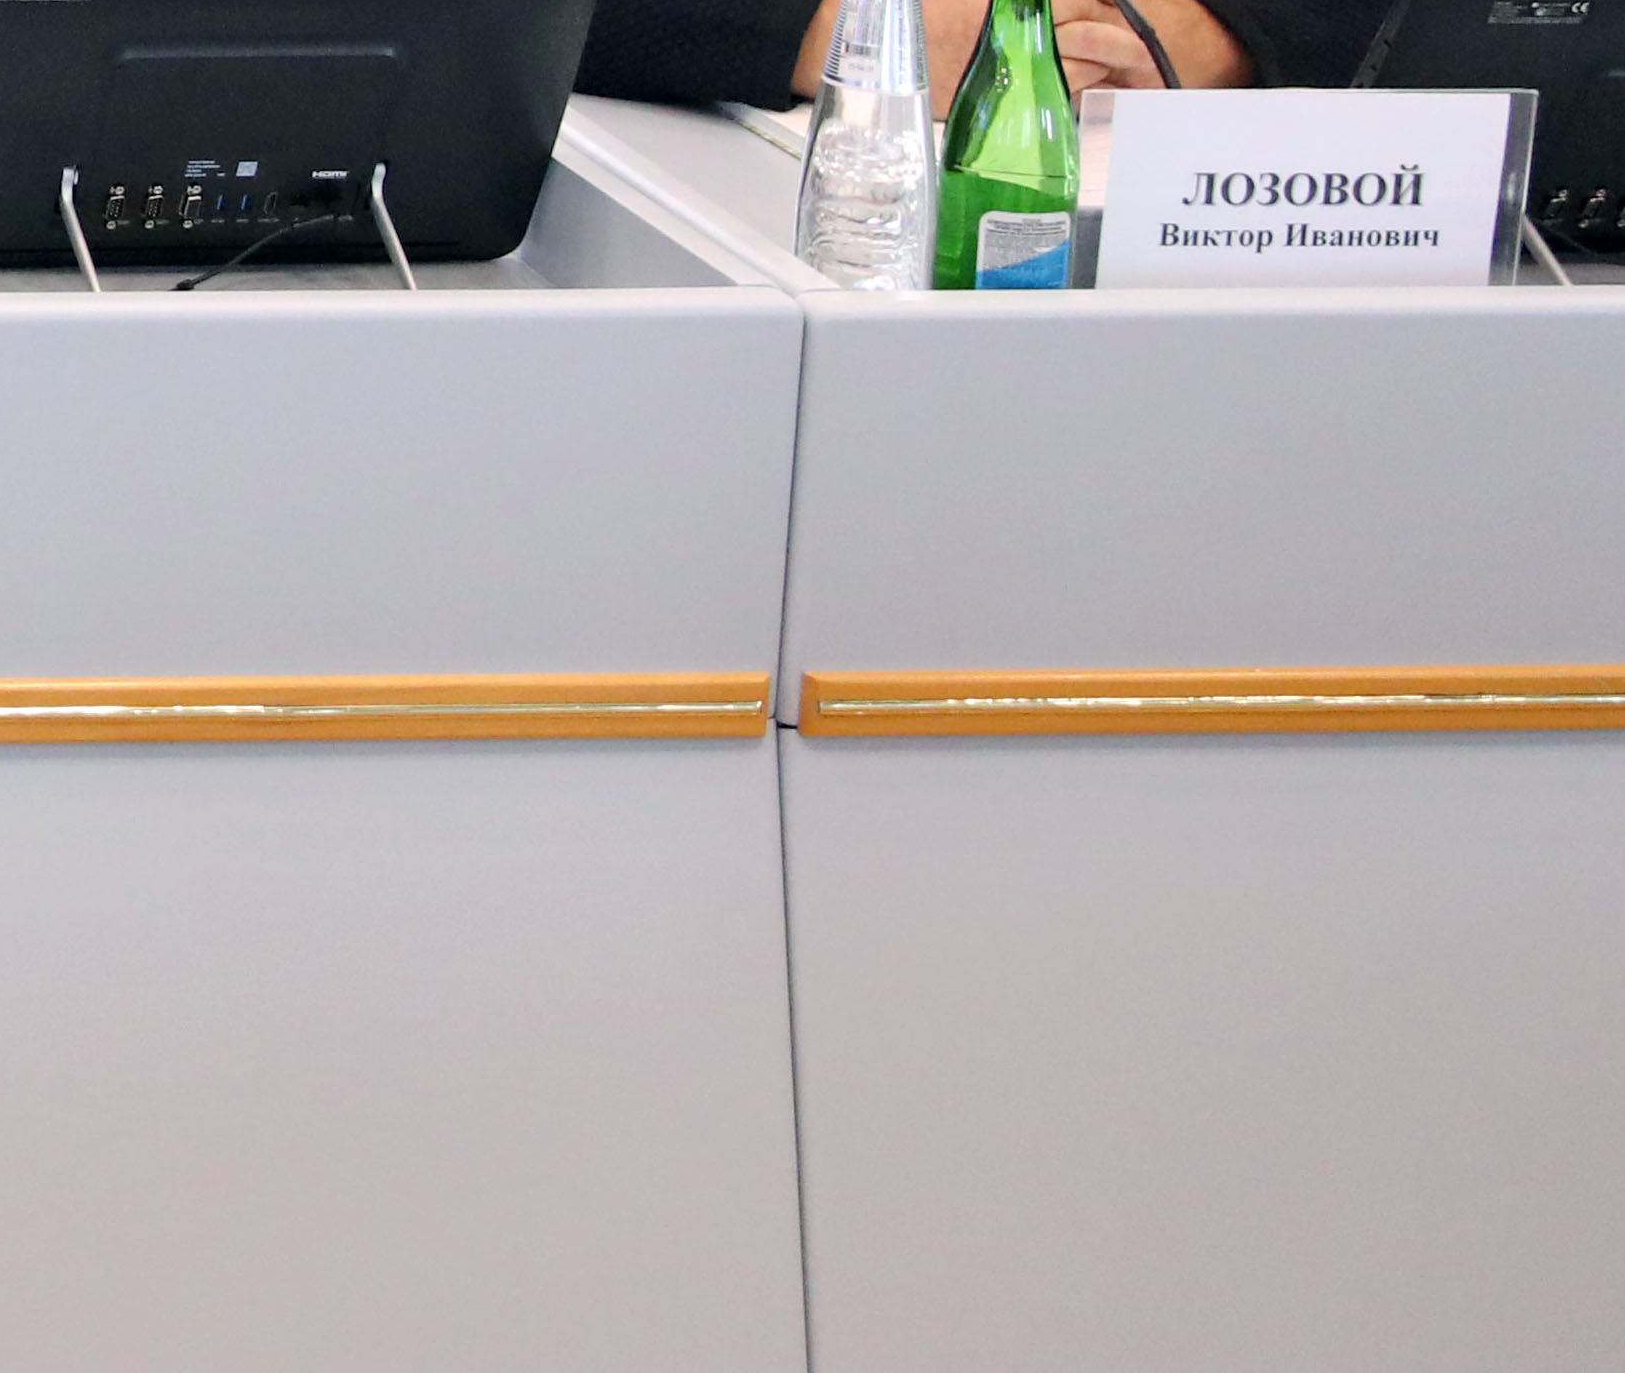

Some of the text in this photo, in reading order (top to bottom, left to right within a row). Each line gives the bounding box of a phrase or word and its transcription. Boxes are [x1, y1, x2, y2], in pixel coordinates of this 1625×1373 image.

[1180, 163, 1426, 207] ЛОЗОВОЙ
[1159, 222, 1441, 254] Виктор Иванович
